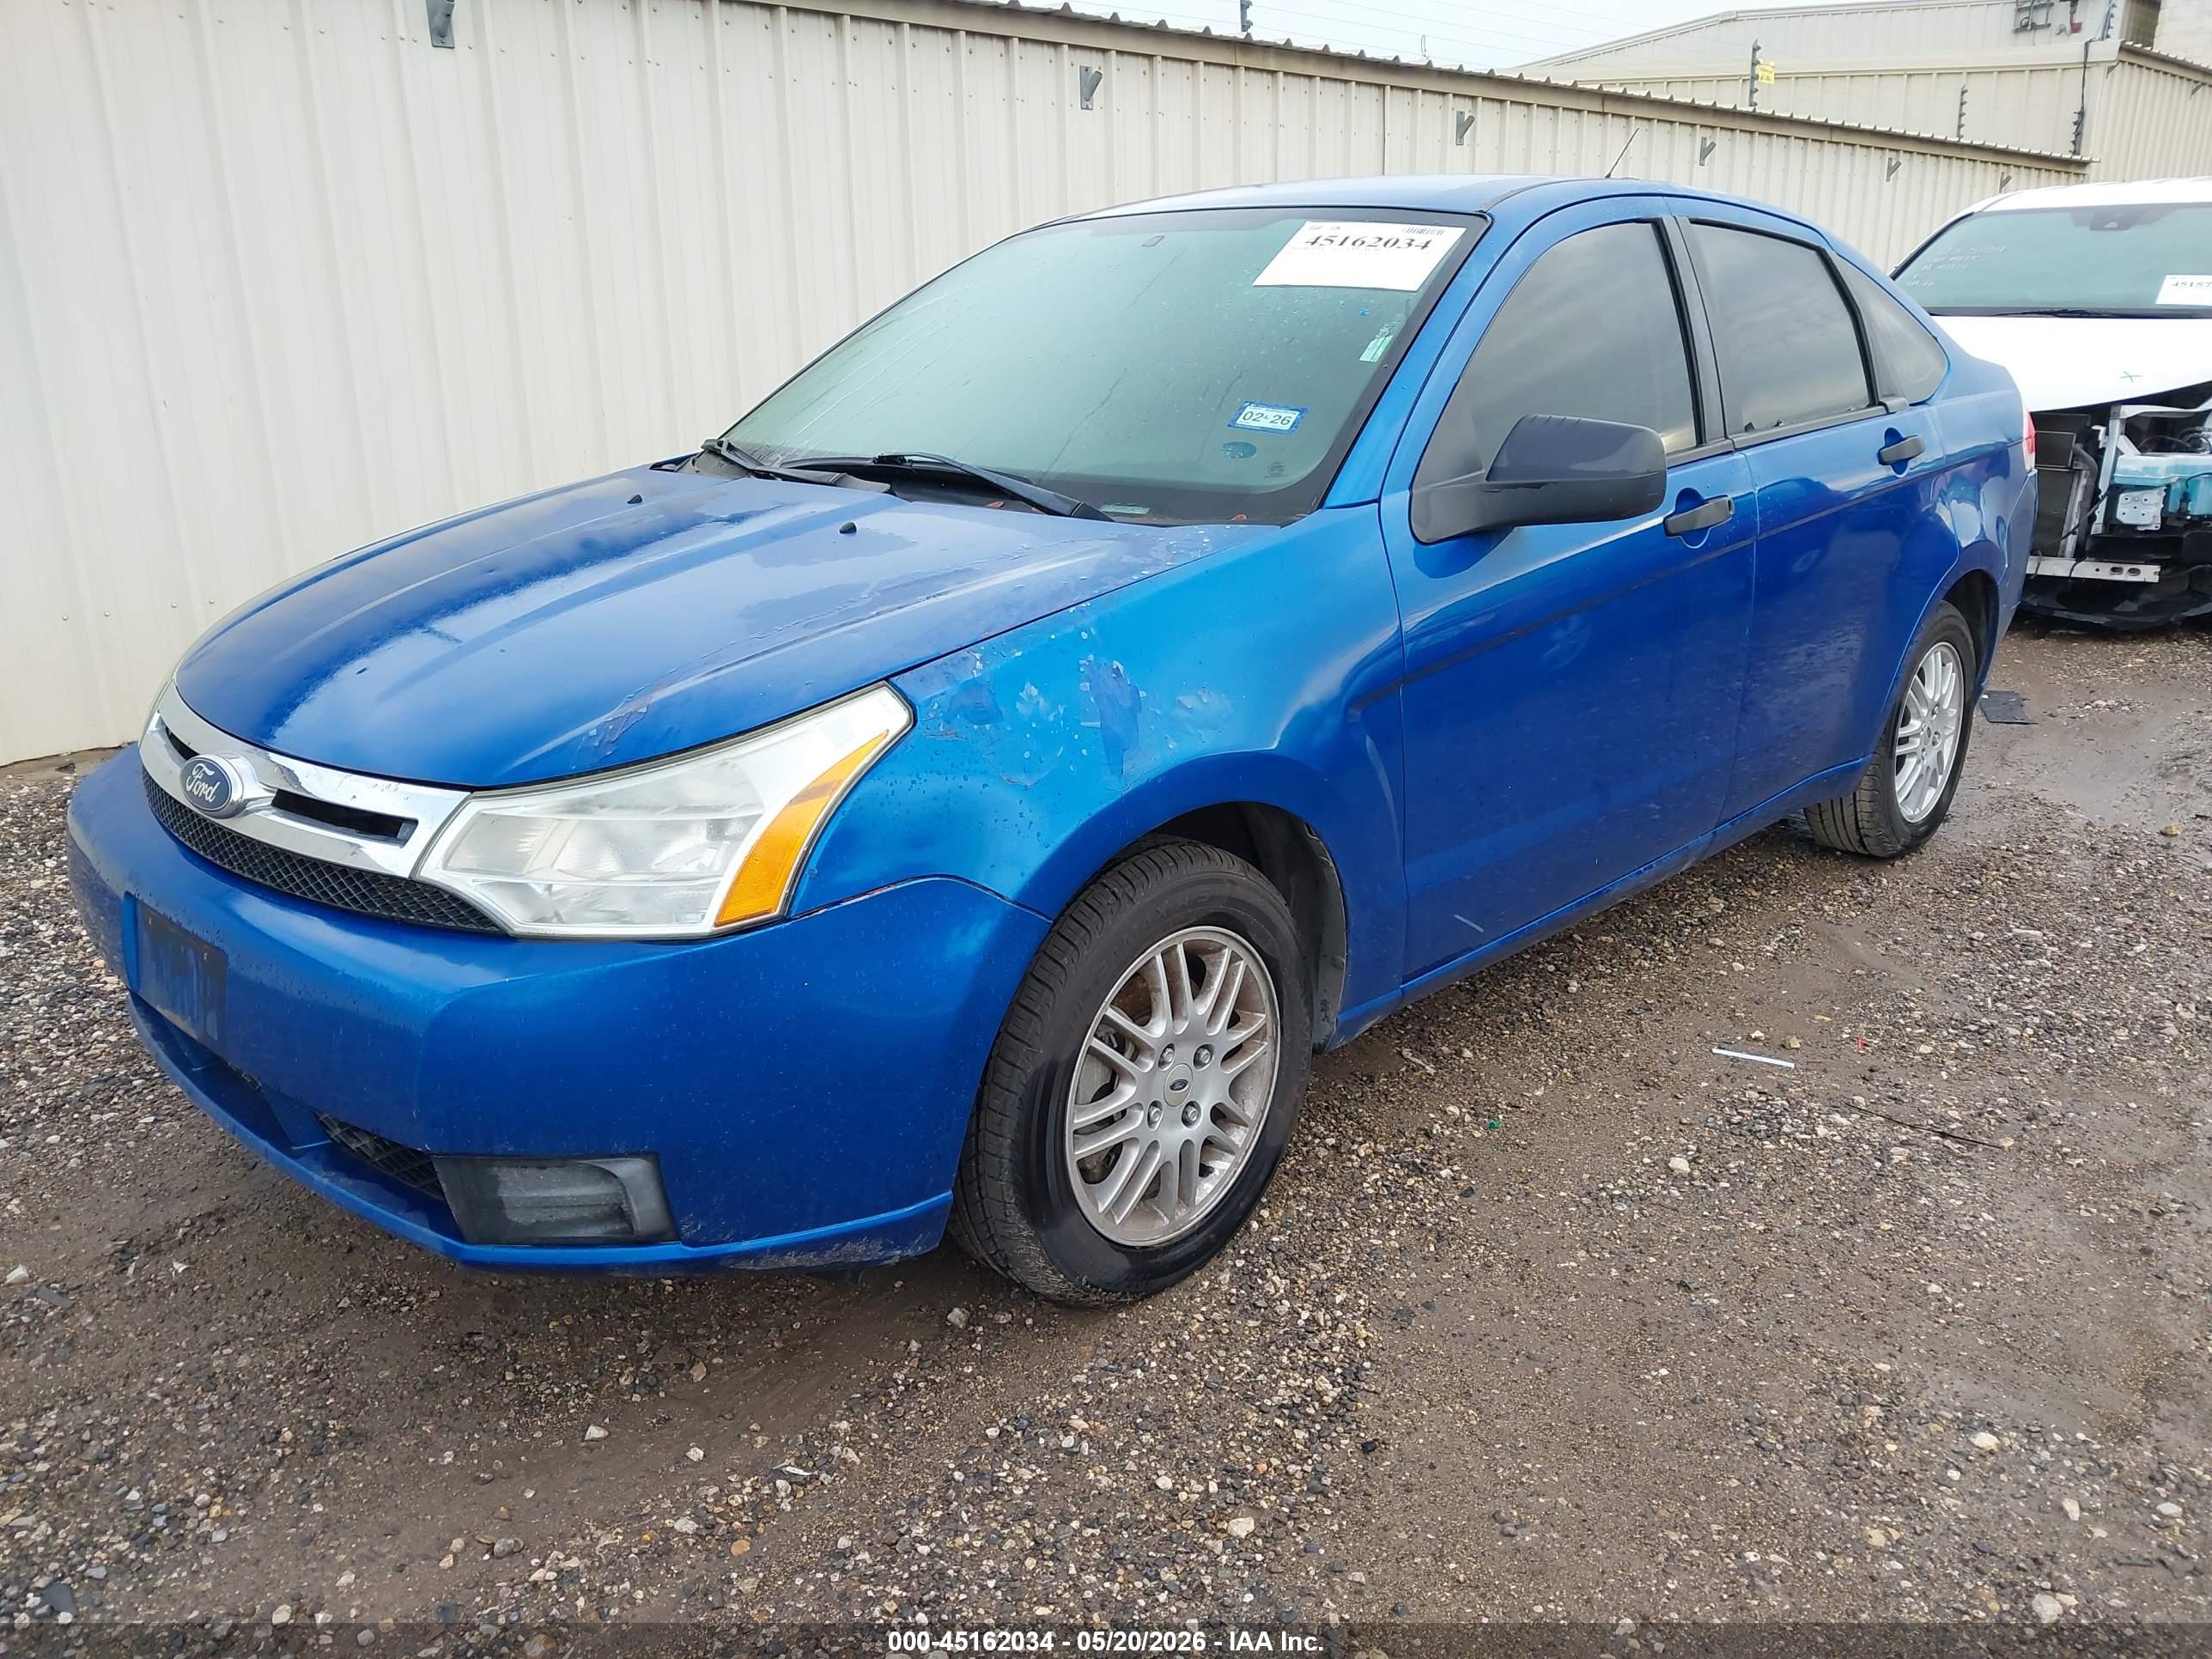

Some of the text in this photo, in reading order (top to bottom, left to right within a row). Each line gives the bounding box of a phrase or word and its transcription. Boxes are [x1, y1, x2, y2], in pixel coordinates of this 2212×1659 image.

[1305, 234, 1432, 250] 45162034
[1243, 411, 1292, 426] 02 26
[185, 763, 221, 803] Ford
